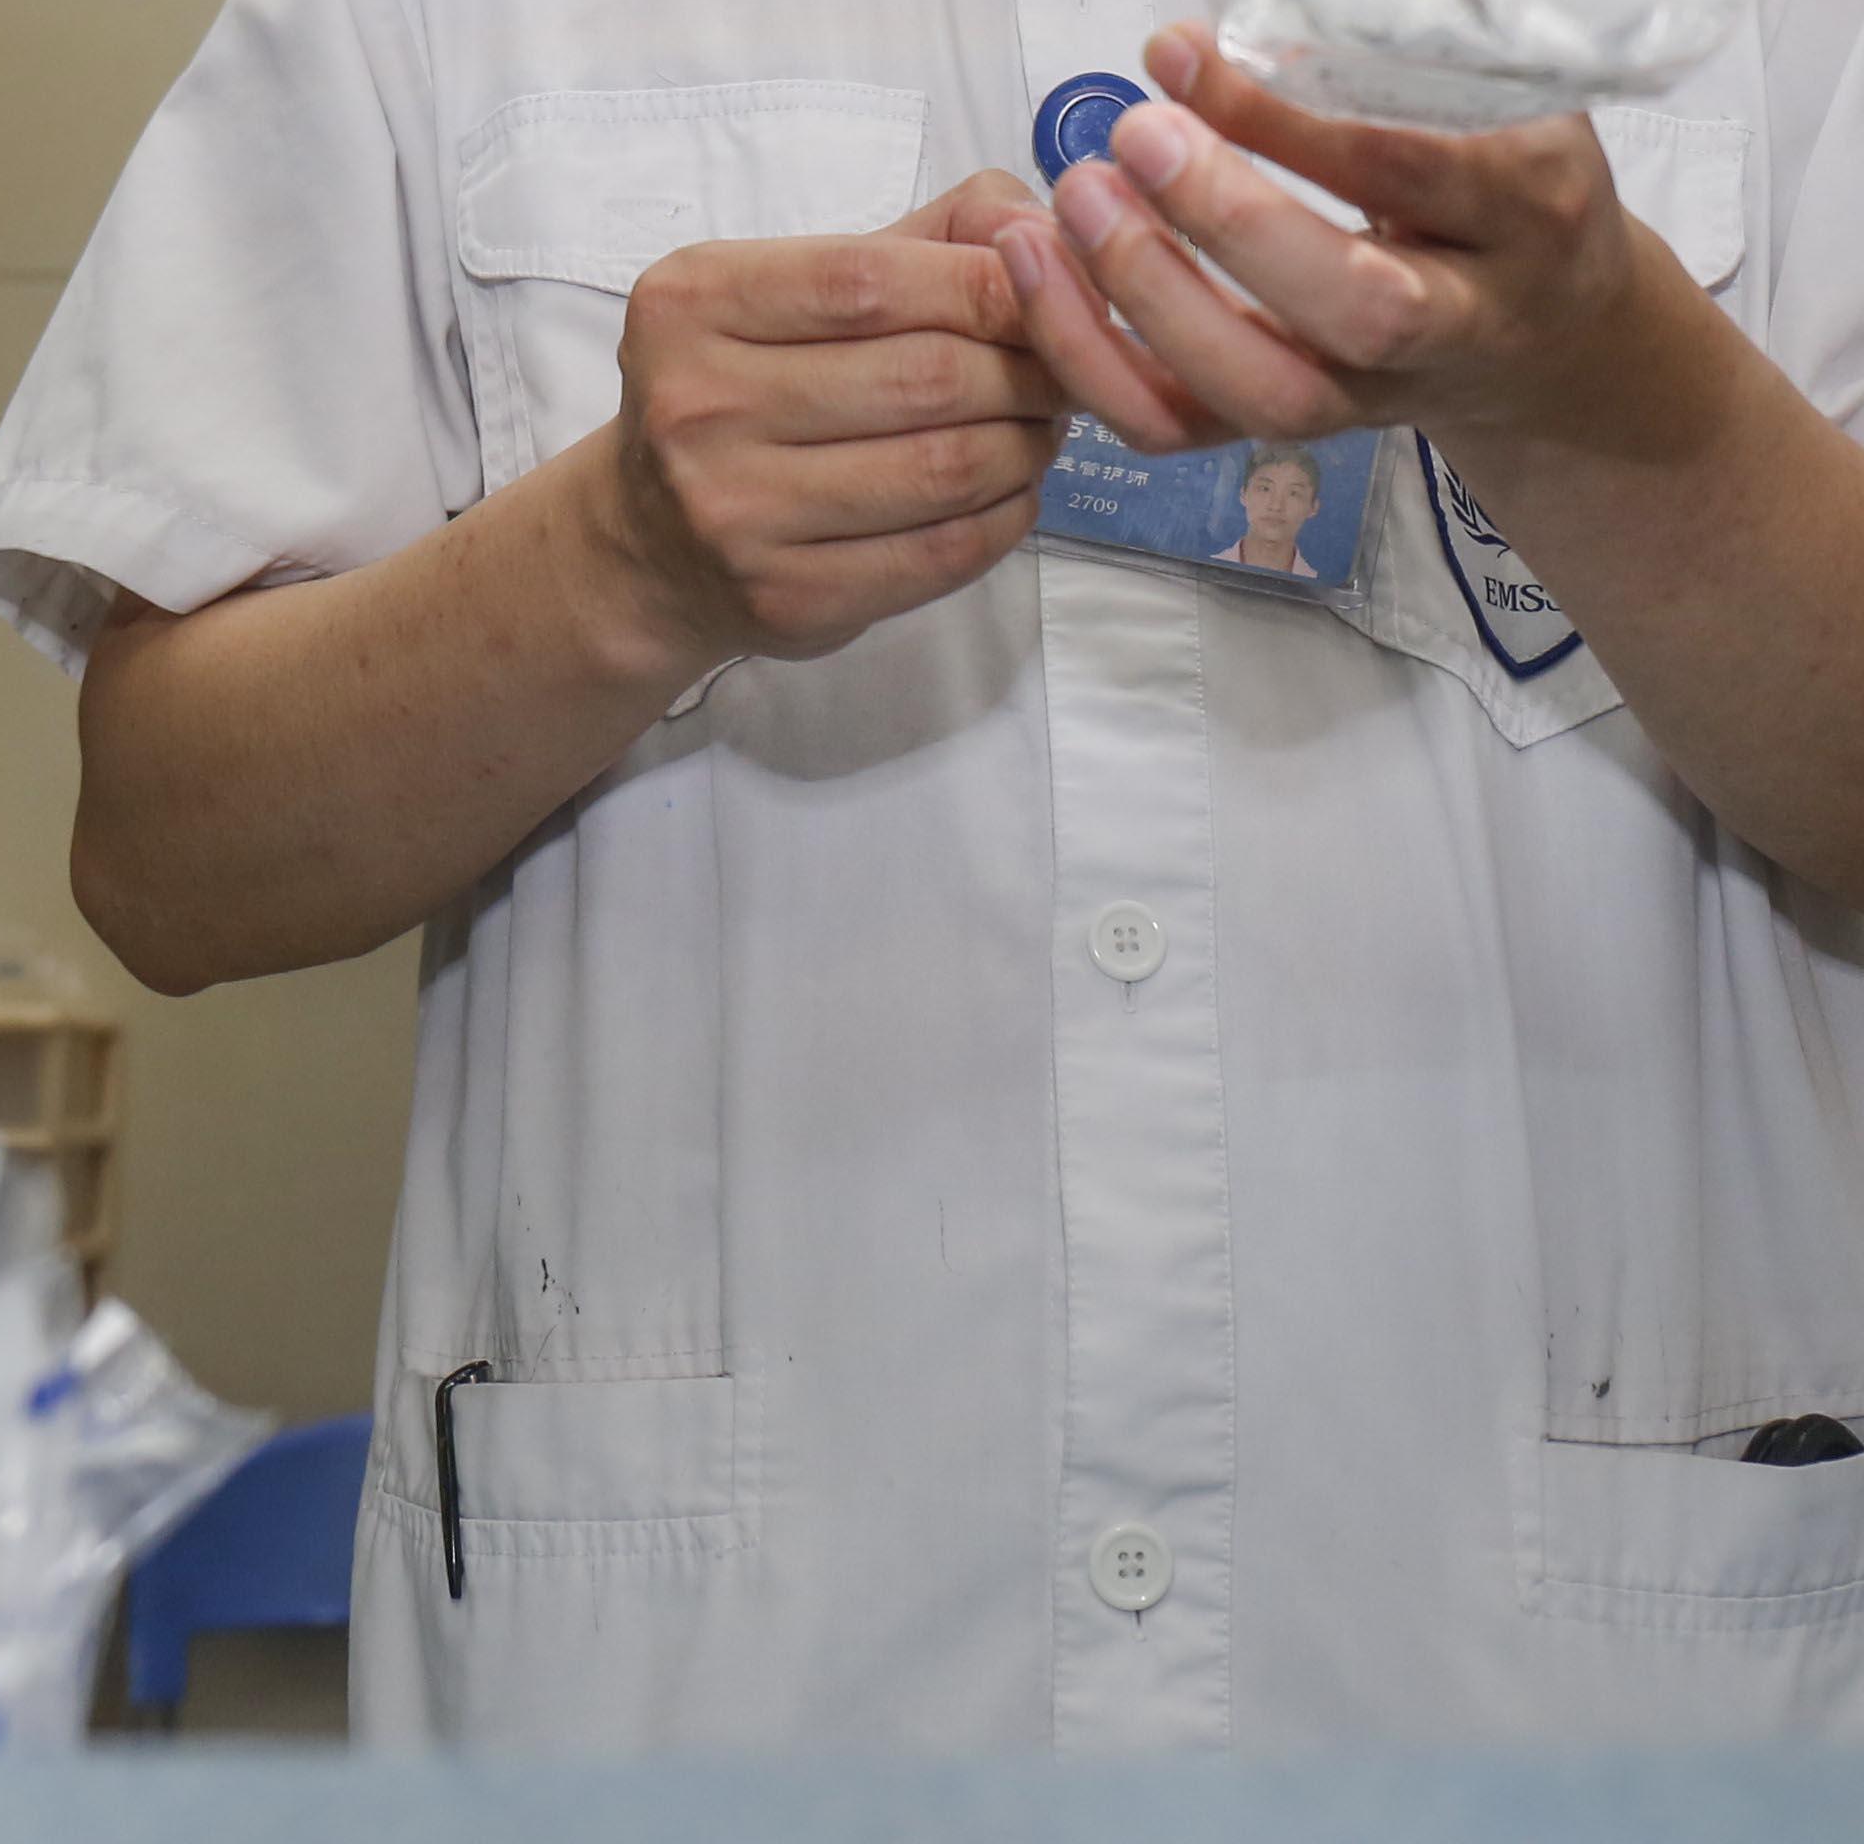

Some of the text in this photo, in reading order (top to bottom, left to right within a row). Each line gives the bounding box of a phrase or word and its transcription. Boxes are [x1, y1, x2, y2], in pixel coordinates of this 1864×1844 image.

[1054, 455, 1151, 487] 主管护师
[1067, 493, 1118, 516] 2709
[1484, 576, 1562, 613] EMS
